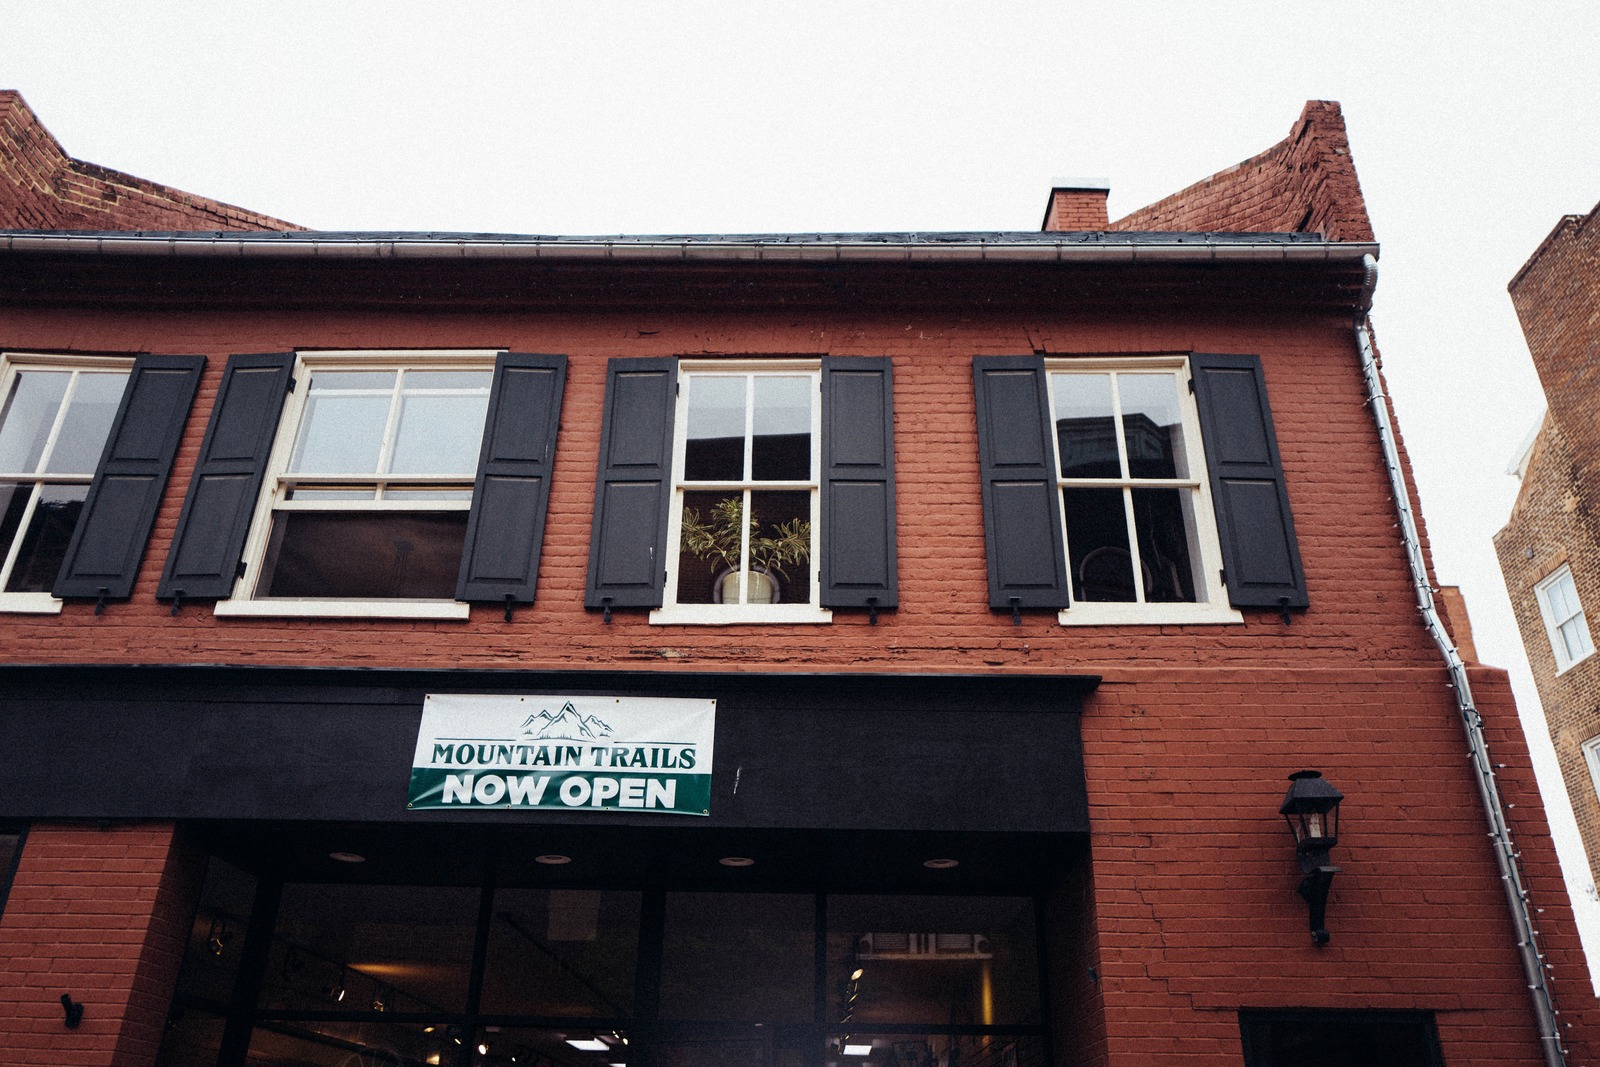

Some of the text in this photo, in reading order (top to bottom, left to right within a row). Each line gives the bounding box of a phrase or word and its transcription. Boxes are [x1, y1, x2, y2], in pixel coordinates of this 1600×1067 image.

[431, 743, 697, 769] MOUNTAIN TRAILS
[441, 774, 677, 809] NOW OPEN
